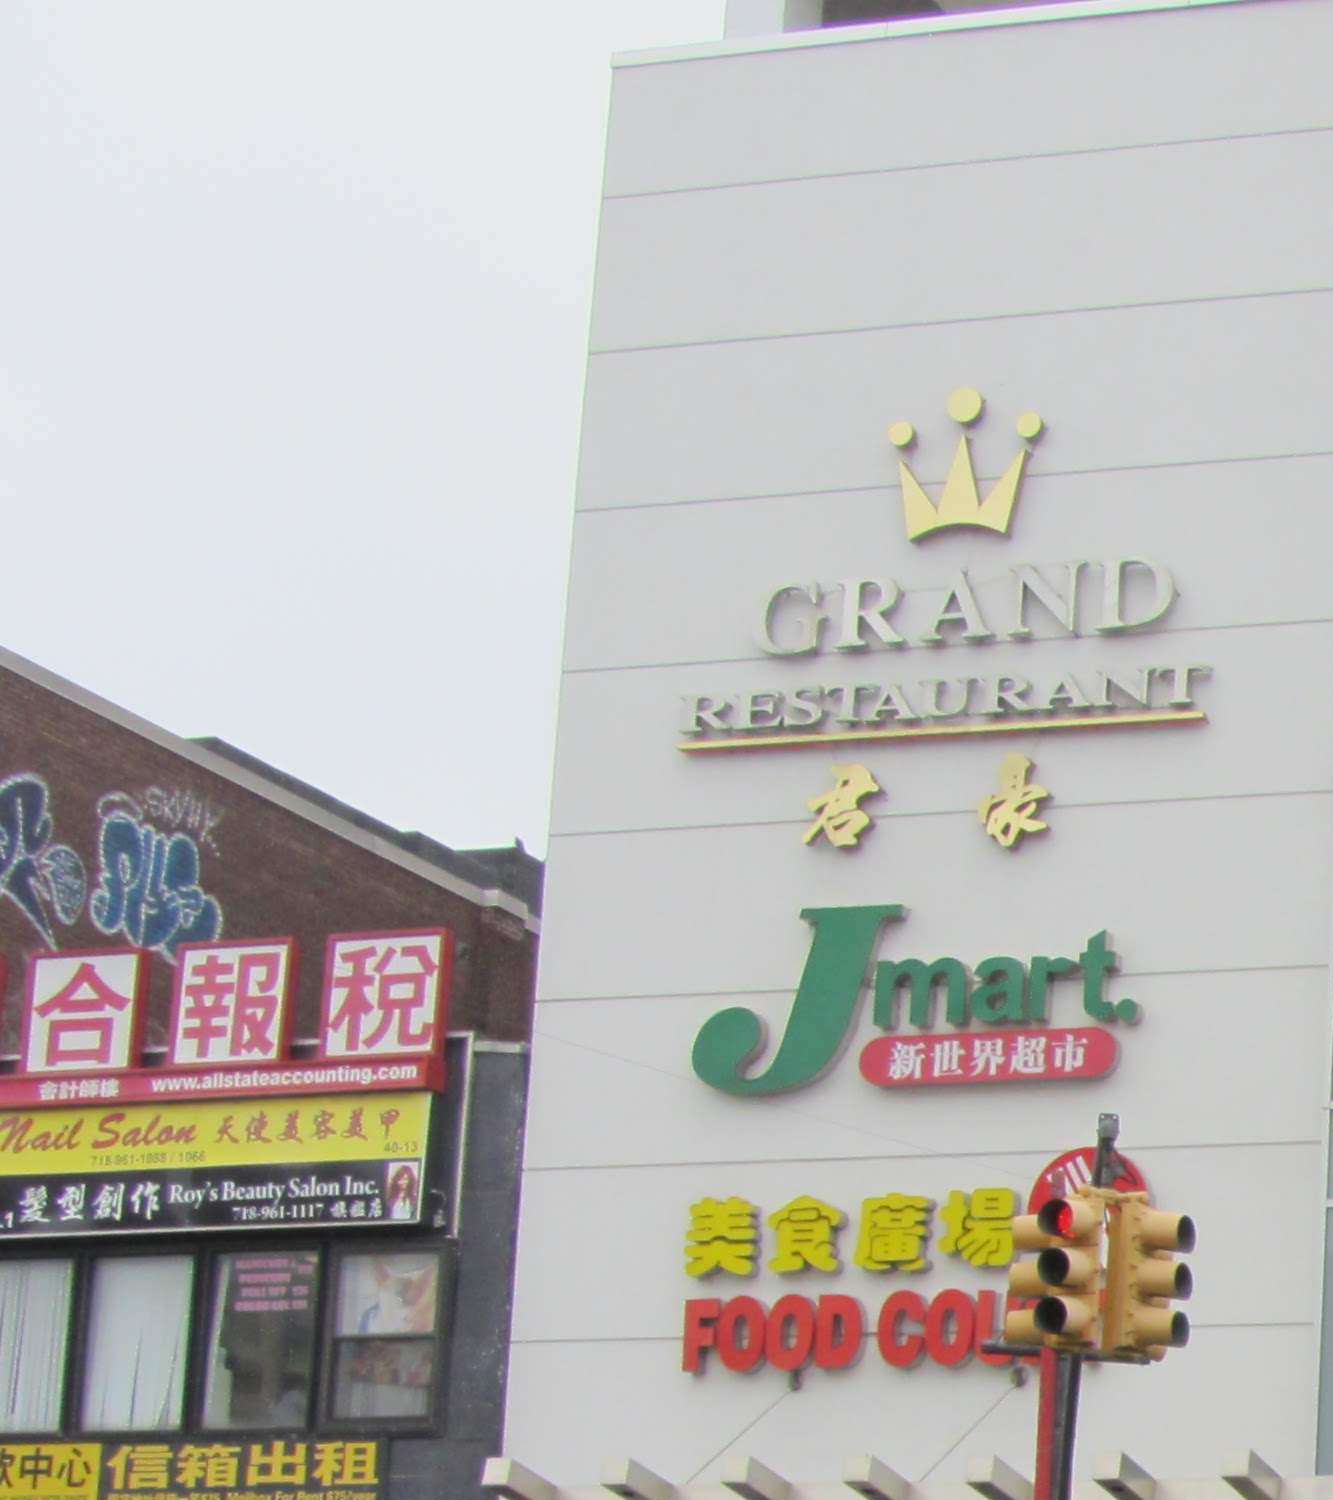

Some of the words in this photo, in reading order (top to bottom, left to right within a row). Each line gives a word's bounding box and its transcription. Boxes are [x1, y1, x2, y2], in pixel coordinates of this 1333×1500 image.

[755, 553, 1180, 660] GRAND
[682, 664, 1213, 736] RESTAURANT
[151, 1064, 418, 1093] www.allstateaccounting.com
[887, 1033, 1089, 1081] 新世界超市
[0, 1116, 84, 1154] Nail
[91, 1111, 197, 1150] Salon
[168, 1182, 218, 1210] Roy's
[223, 1178, 285, 1208] Beauty
[287, 1174, 342, 1198] Salon
[345, 1174, 380, 1195] Inc.
[684, 1186, 1015, 1279] 美食廣場
[681, 1293, 863, 1374] FOOD
[107, 1440, 379, 1490] 信箱出租
